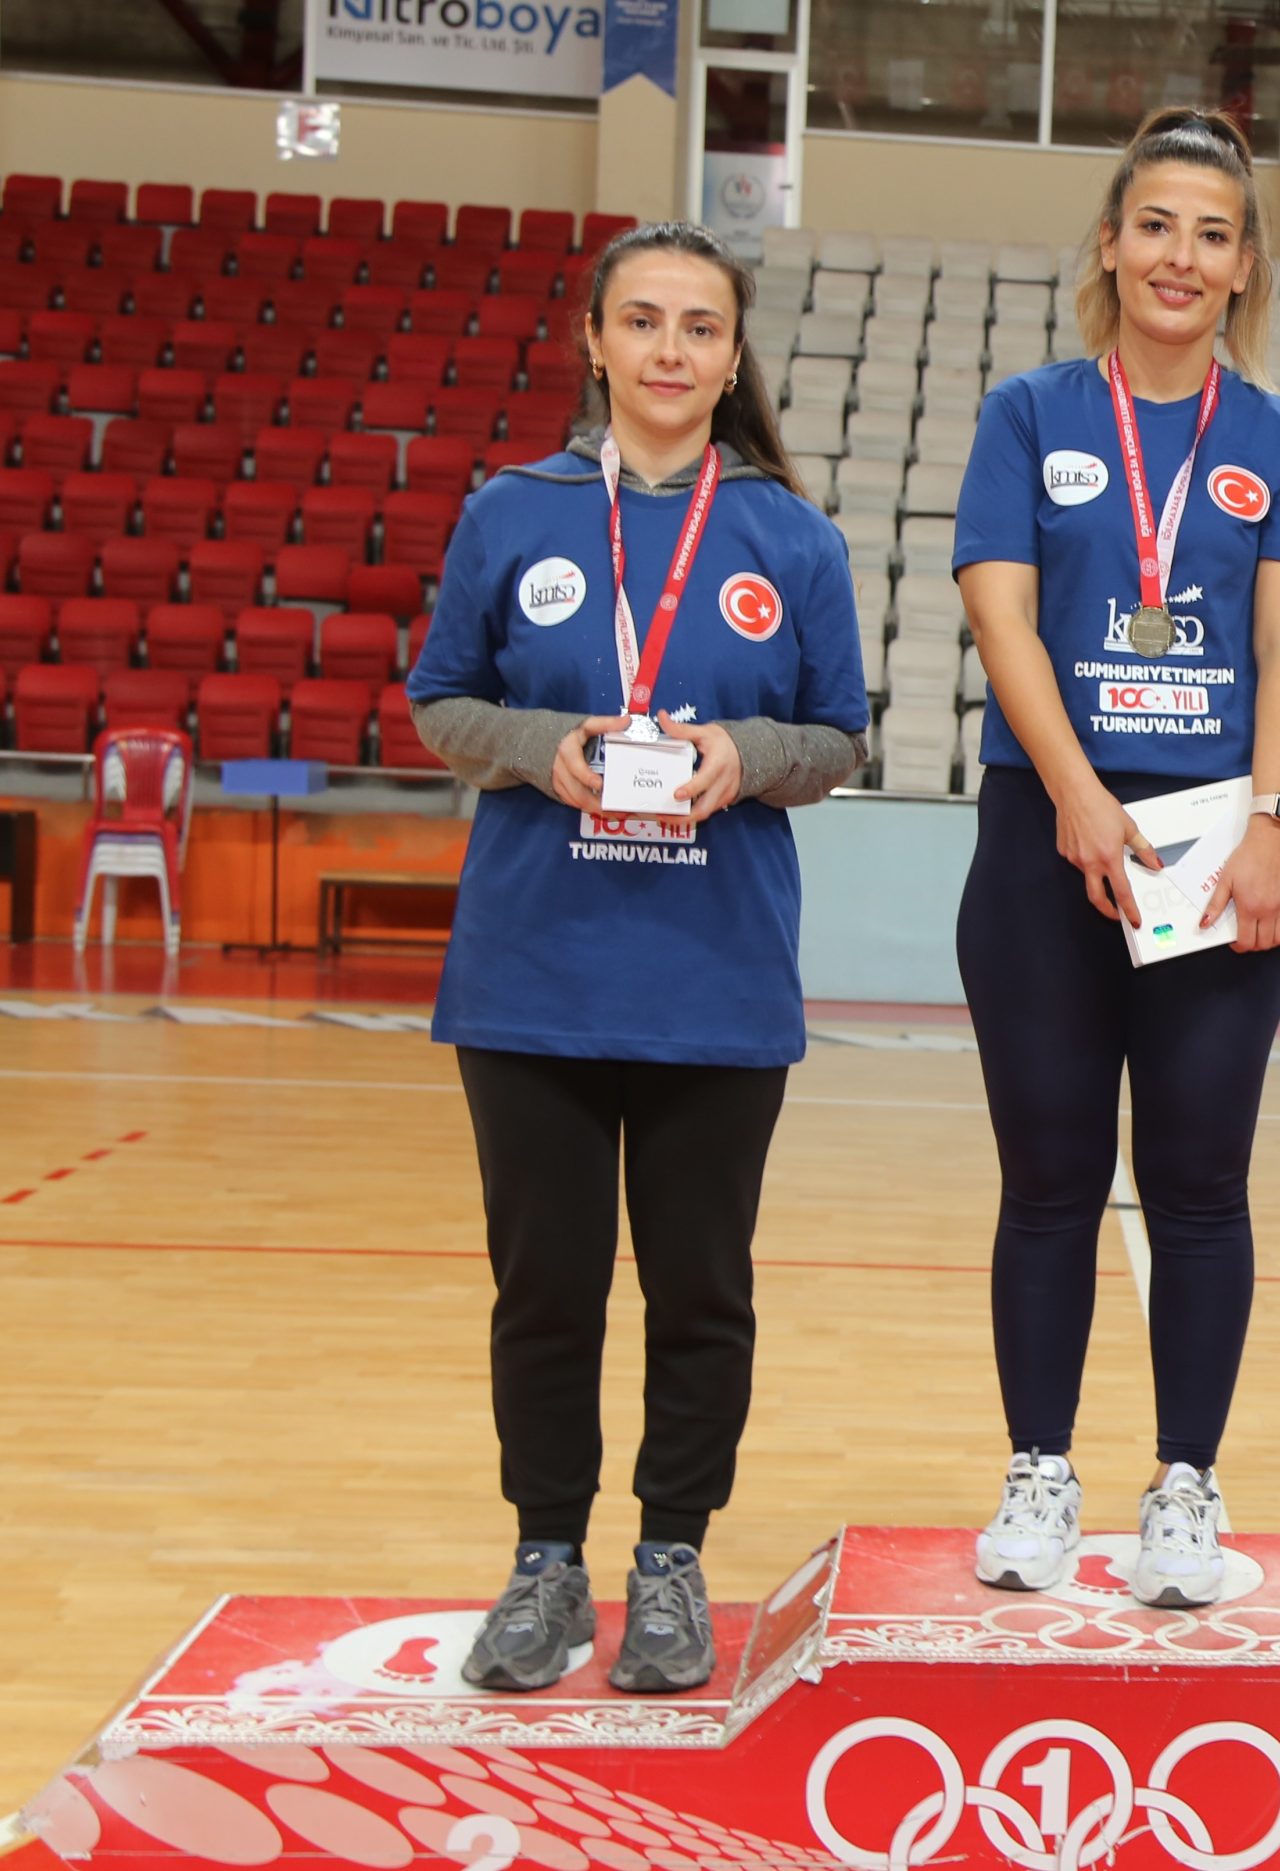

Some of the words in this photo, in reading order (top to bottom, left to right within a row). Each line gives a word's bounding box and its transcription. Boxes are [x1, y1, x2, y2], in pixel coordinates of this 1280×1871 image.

[327, 26, 394, 43] Kimyasal
[432, 35, 449, 47] ve
[1129, 456, 1139, 469] VE
[1131, 468, 1143, 491] SPOR
[687, 509, 703, 533] SPOR
[1171, 690, 1204, 711] YILI
[1090, 715, 1222, 735] TURNUVALARI
[633, 776, 663, 789] icon
[569, 841, 708, 866] TURNUVALARI
[1022, 1747, 1071, 1835] 1
[446, 1813, 521, 1871] 2
